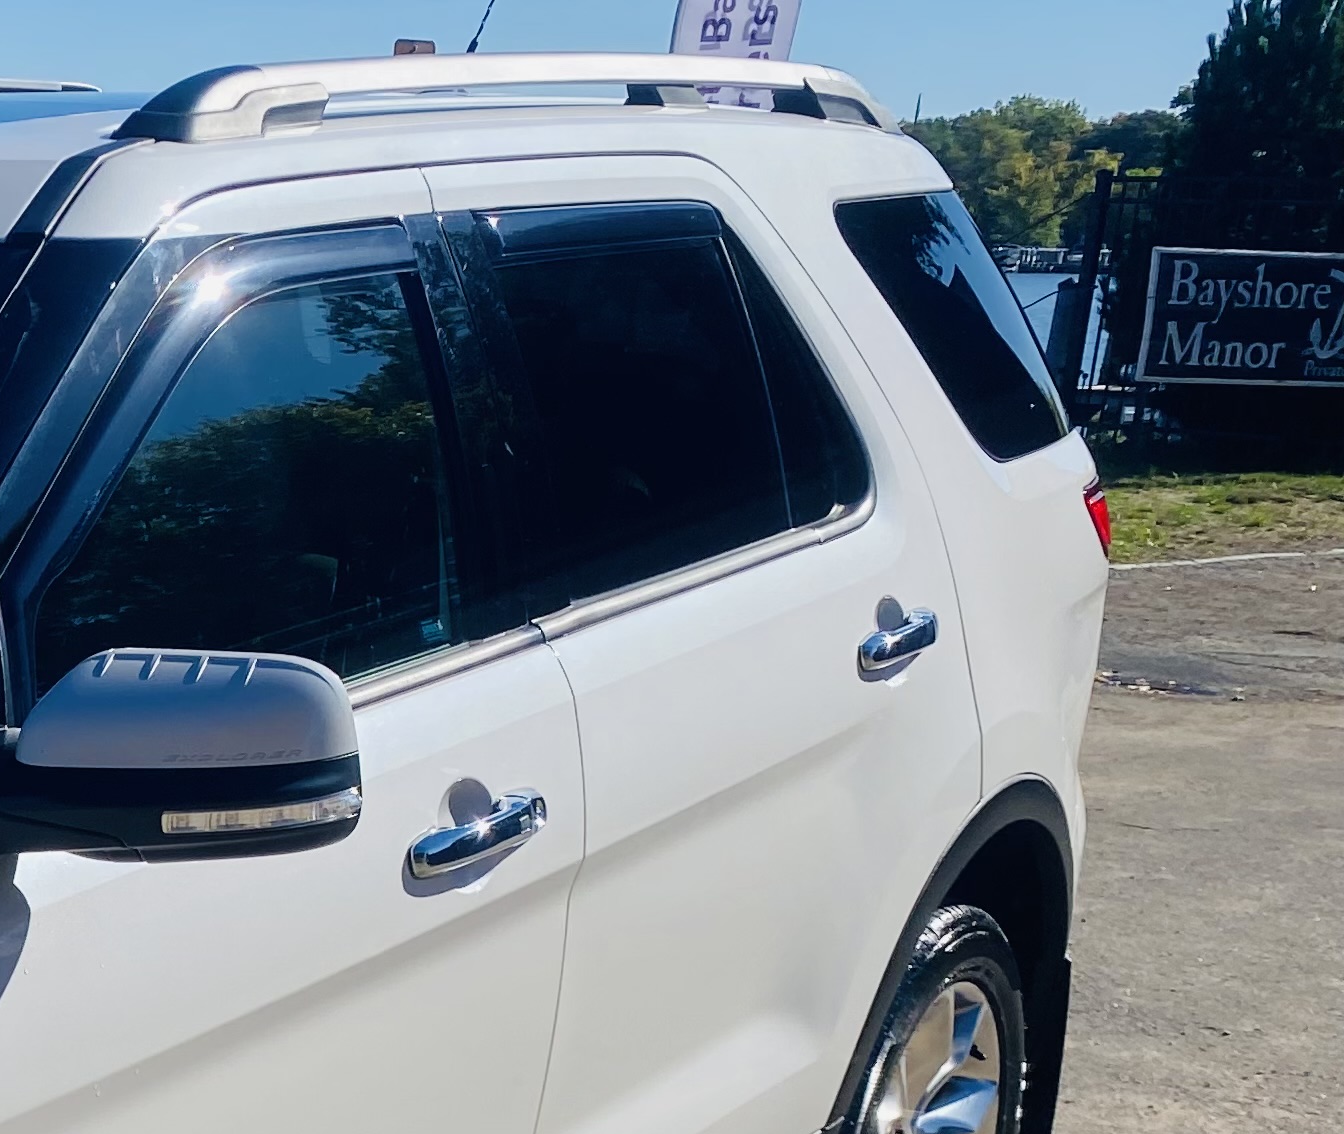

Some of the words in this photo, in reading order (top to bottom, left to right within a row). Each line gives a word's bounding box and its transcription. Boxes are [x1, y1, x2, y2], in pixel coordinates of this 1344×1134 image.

[1167, 259, 1332, 324] Bayshore
[1159, 320, 1287, 369] Manor
[162, 749, 303, 763] EXPLORER
